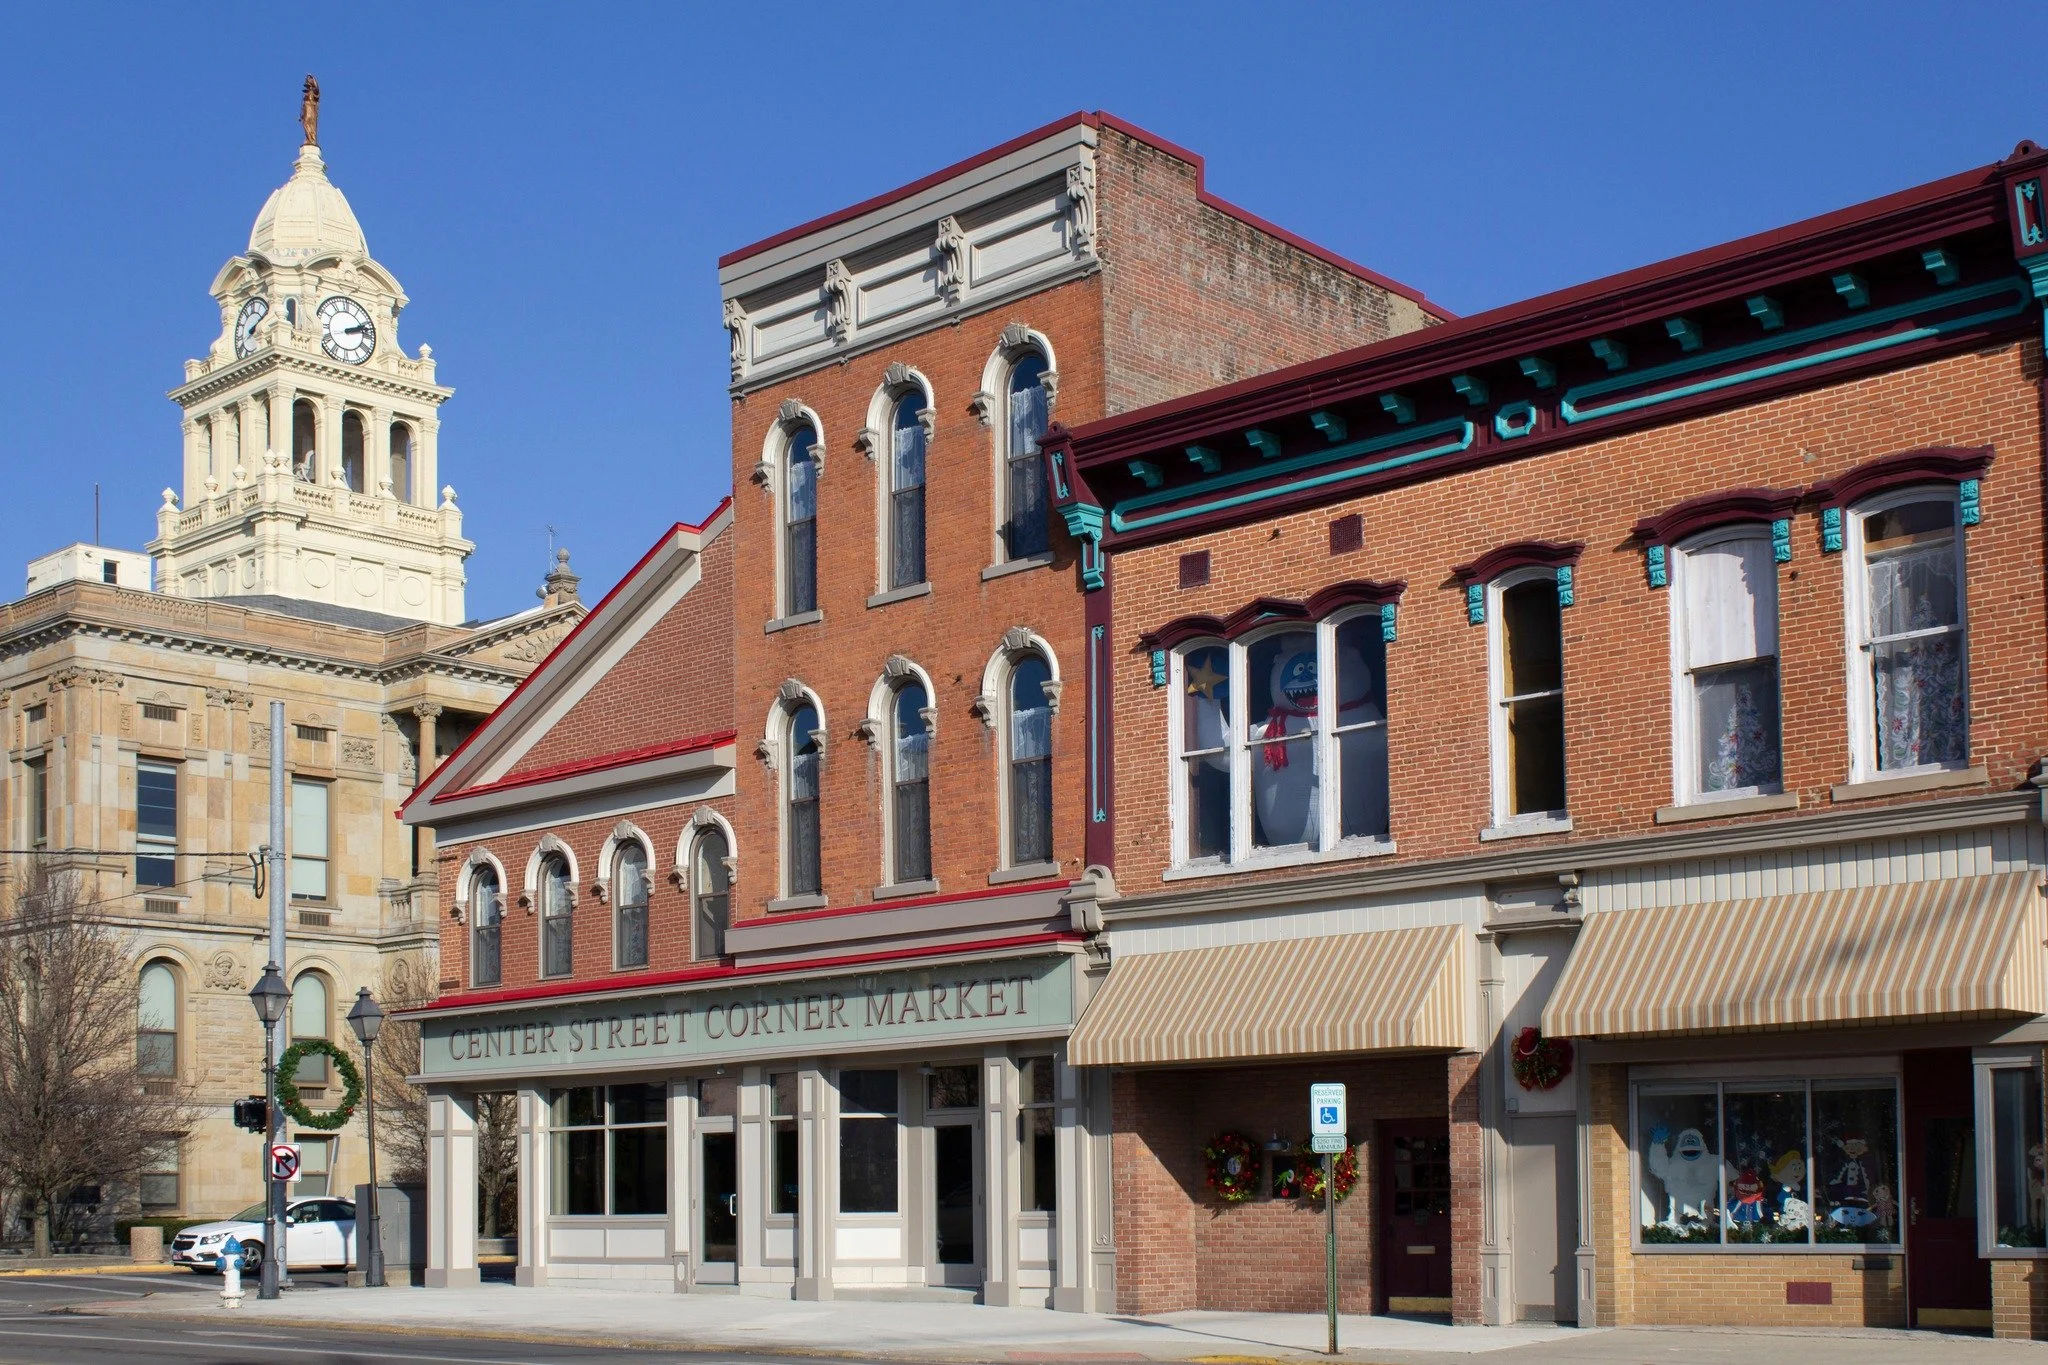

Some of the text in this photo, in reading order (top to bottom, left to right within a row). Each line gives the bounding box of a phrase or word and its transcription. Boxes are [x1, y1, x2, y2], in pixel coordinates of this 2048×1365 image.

[449, 975, 1033, 1060] CENTER STREET CORNER MARKET
